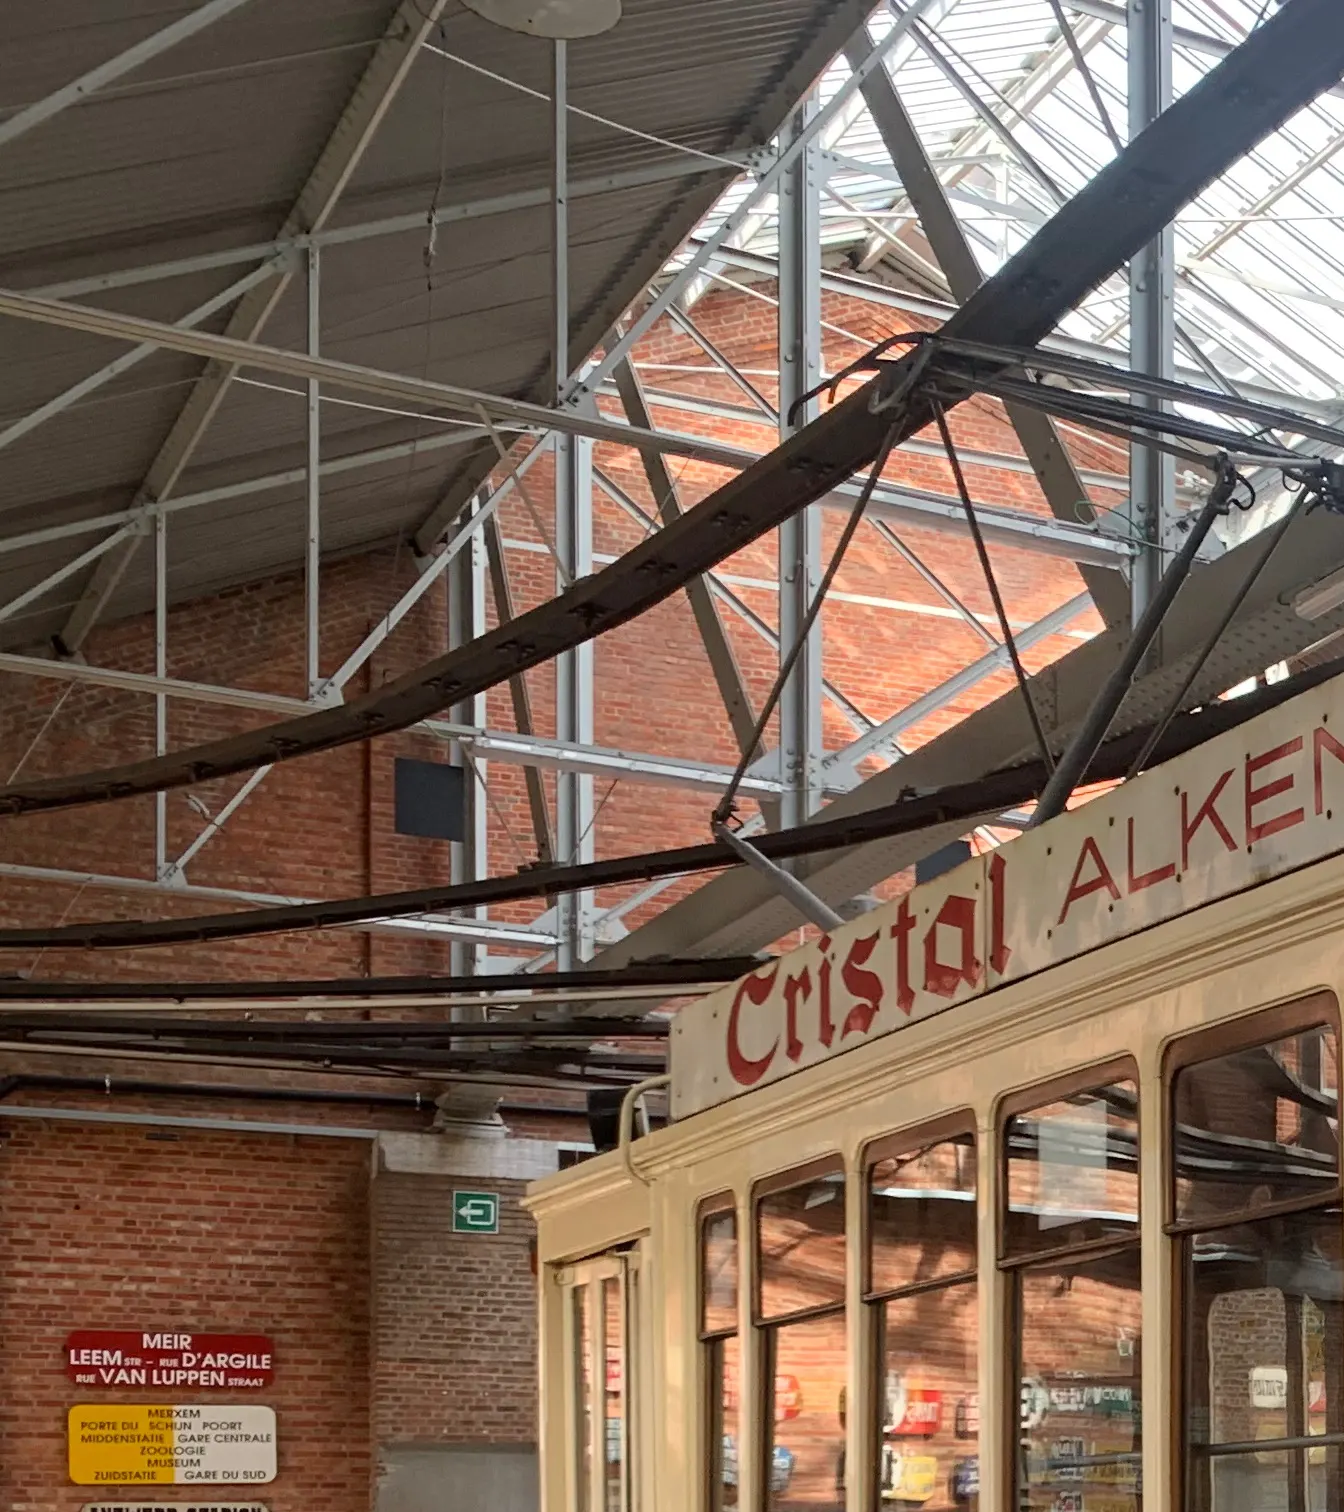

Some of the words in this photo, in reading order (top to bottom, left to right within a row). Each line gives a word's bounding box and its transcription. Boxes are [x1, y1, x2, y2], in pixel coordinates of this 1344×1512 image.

[726, 851, 1013, 1086] Cristal
[142, 1333, 192, 1350] MEIR
[69, 1349, 122, 1366] LEEM
[124, 1358, 141, 1366] STR
[159, 1358, 179, 1367] RUE
[182, 1352, 271, 1370] D'ARGILE
[76, 1374, 96, 1383] RUE
[99, 1368, 146, 1385] VAN
[152, 1370, 225, 1387] LUPPEN
[227, 1377, 264, 1387] STRAAT
[148, 1408, 201, 1419] MERXEM
[80, 1421, 118, 1431] PORTE
[121, 1421, 139, 1431] DU
[202, 1421, 243, 1431] POORT
[80, 1433, 165, 1444] MIDDENSTATIE
[177, 1433, 211, 1444] GARE
[213, 1433, 272, 1444] CENTRALE
[139, 1445, 206, 1456] ZOOLOGIE
[147, 1458, 201, 1468] MUSEUM
[94, 1470, 157, 1481] ZUIDSTATIE
[184, 1470, 218, 1480] GARE
[222, 1470, 239, 1480] DU
[242, 1470, 266, 1480] SUD
